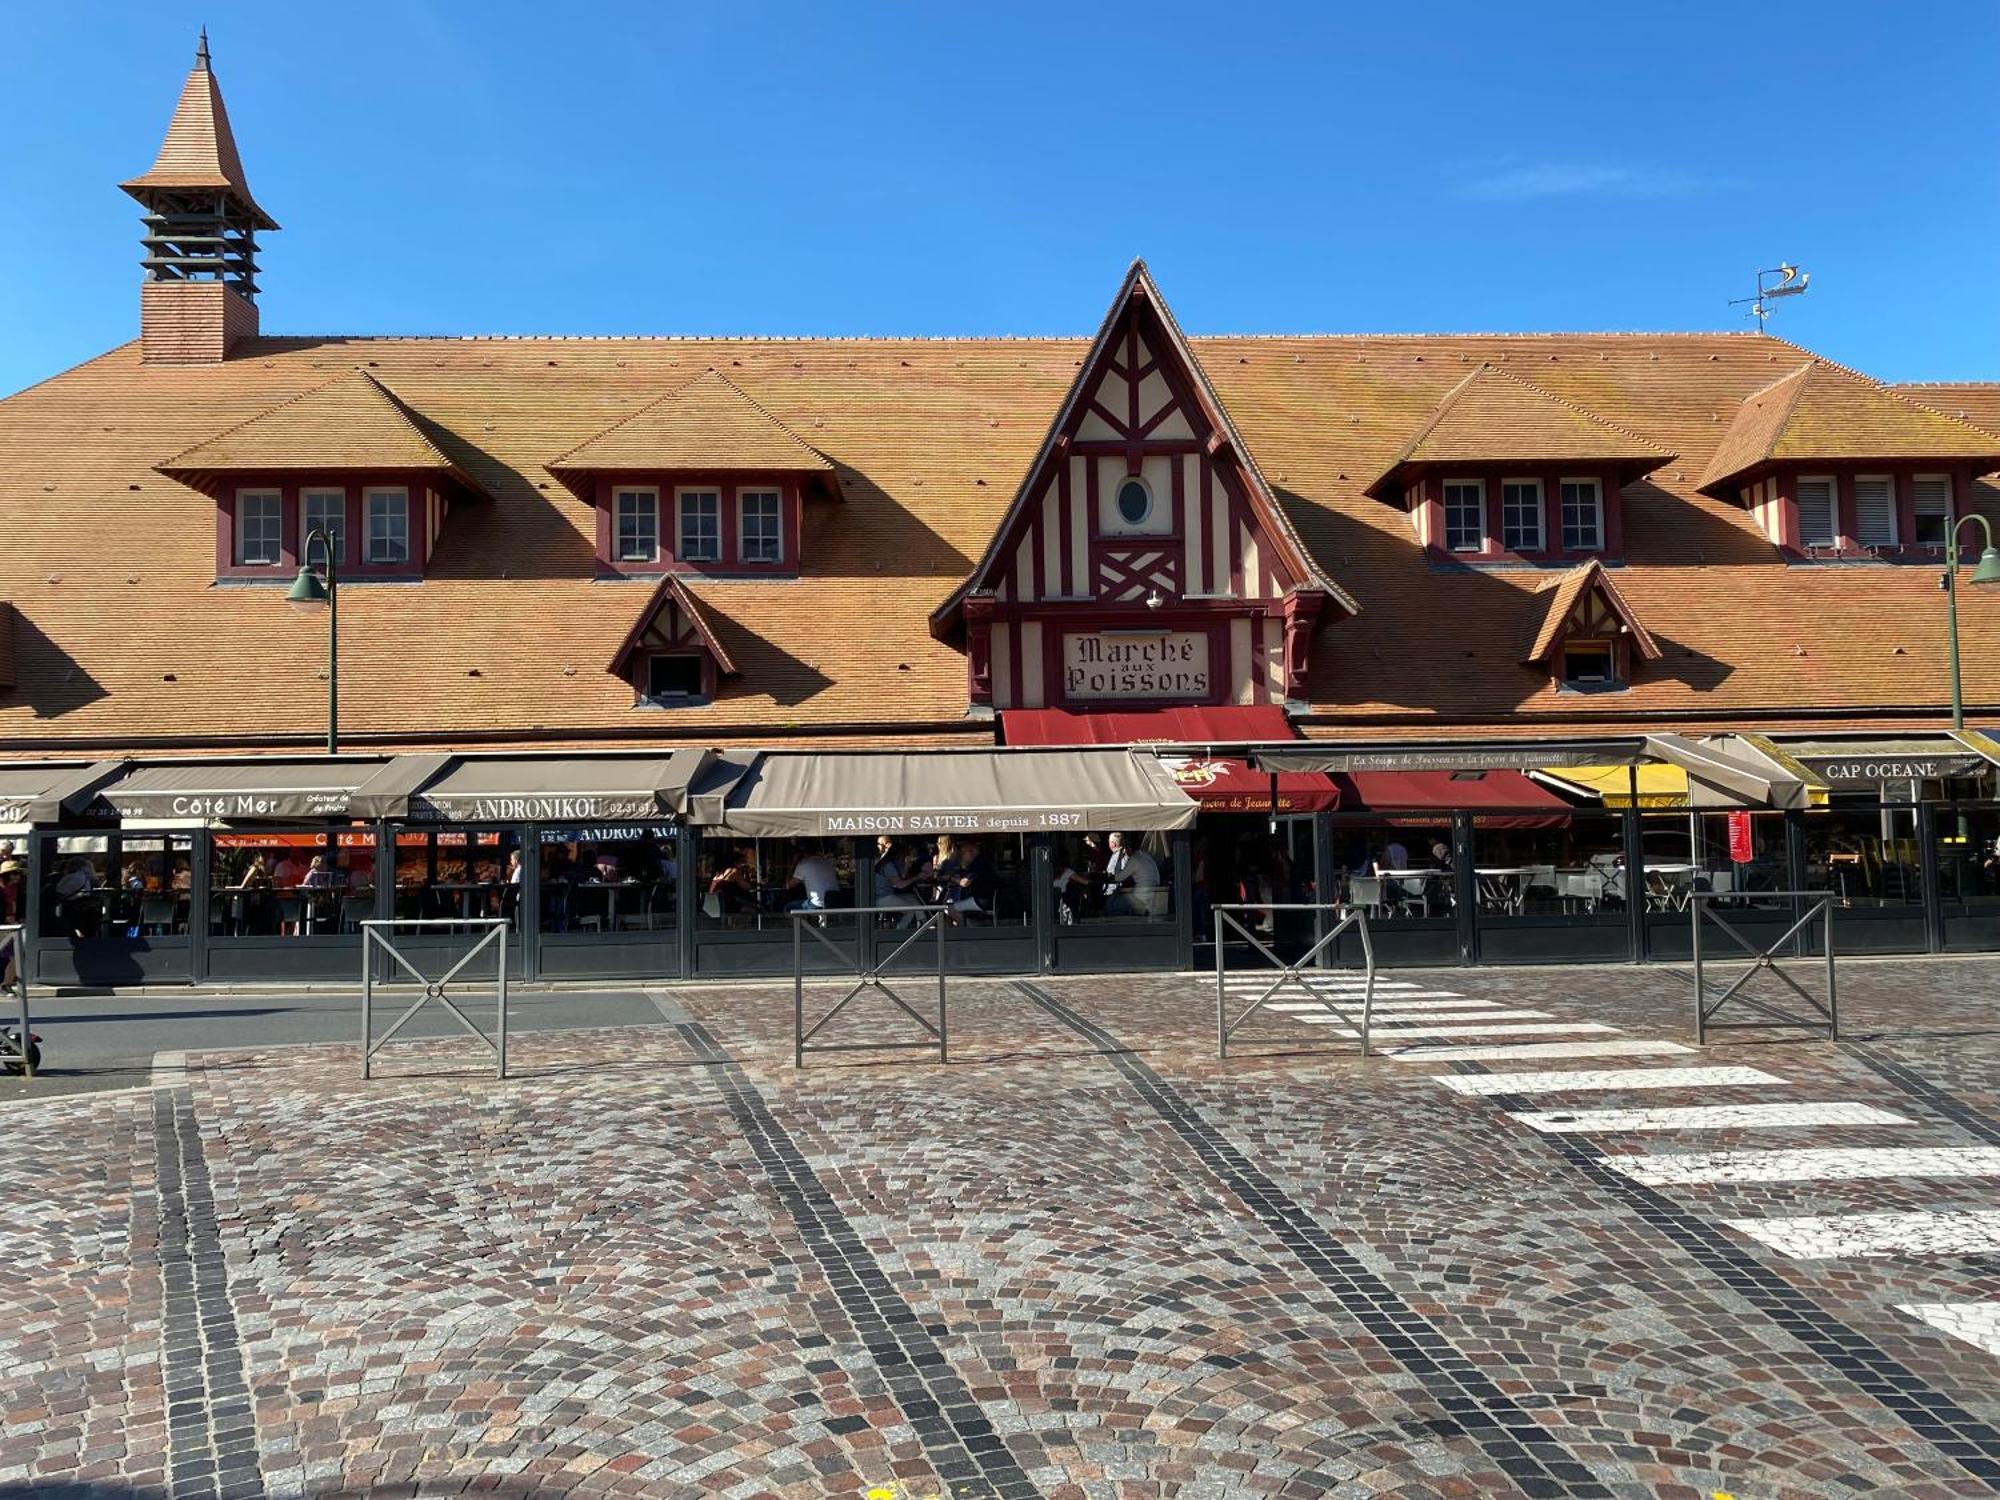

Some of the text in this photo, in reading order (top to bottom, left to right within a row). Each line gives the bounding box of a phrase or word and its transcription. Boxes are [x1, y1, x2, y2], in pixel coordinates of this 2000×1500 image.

[1077, 637, 1194, 663] Marché
[1121, 663, 1156, 672] aux
[1067, 666, 1207, 692] Poissons
[1401, 754, 1411, 765] de
[1826, 764, 1861, 779] CAP
[1865, 763, 1938, 778] OCEANE
[173, 795, 278, 815] Côté Mer
[472, 797, 603, 820] ANDRONIKOU
[1230, 797, 1242, 808] de
[827, 813, 1081, 830] MAISON SAITER depuis 1887
